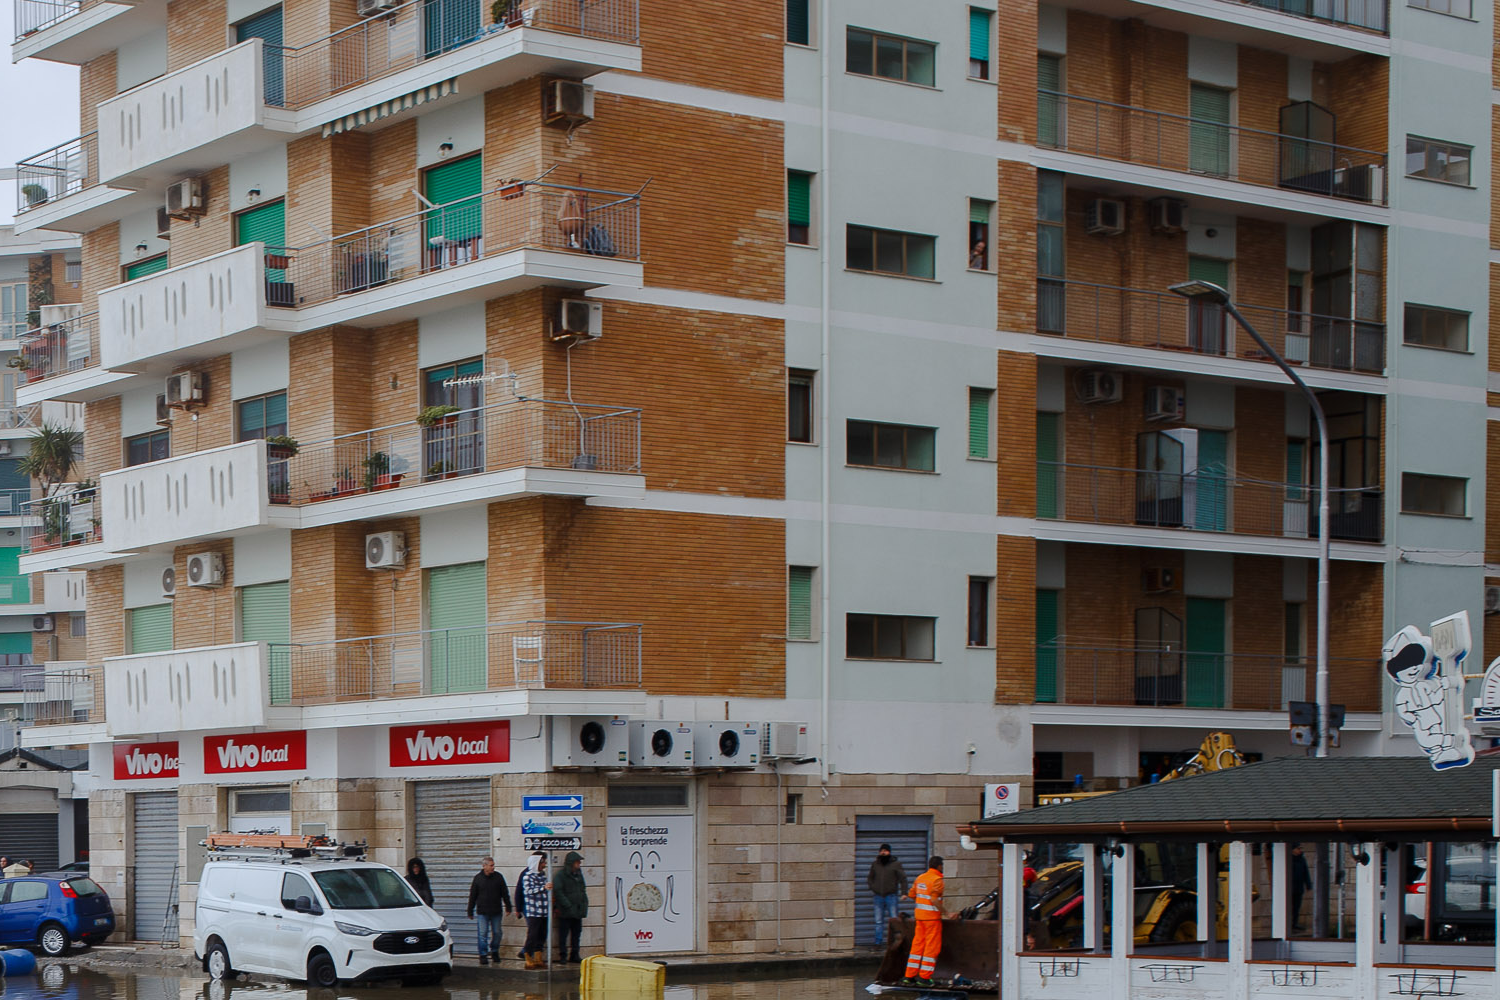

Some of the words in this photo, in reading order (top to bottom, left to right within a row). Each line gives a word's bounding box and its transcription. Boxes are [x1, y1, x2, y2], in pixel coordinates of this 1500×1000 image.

[457, 735, 489, 755] local
[260, 744, 289, 764] local
[620, 826, 628, 835] la
[629, 826, 669, 836] freschezza
[622, 837, 628, 846] ti
[629, 837, 668, 847] sorprende
